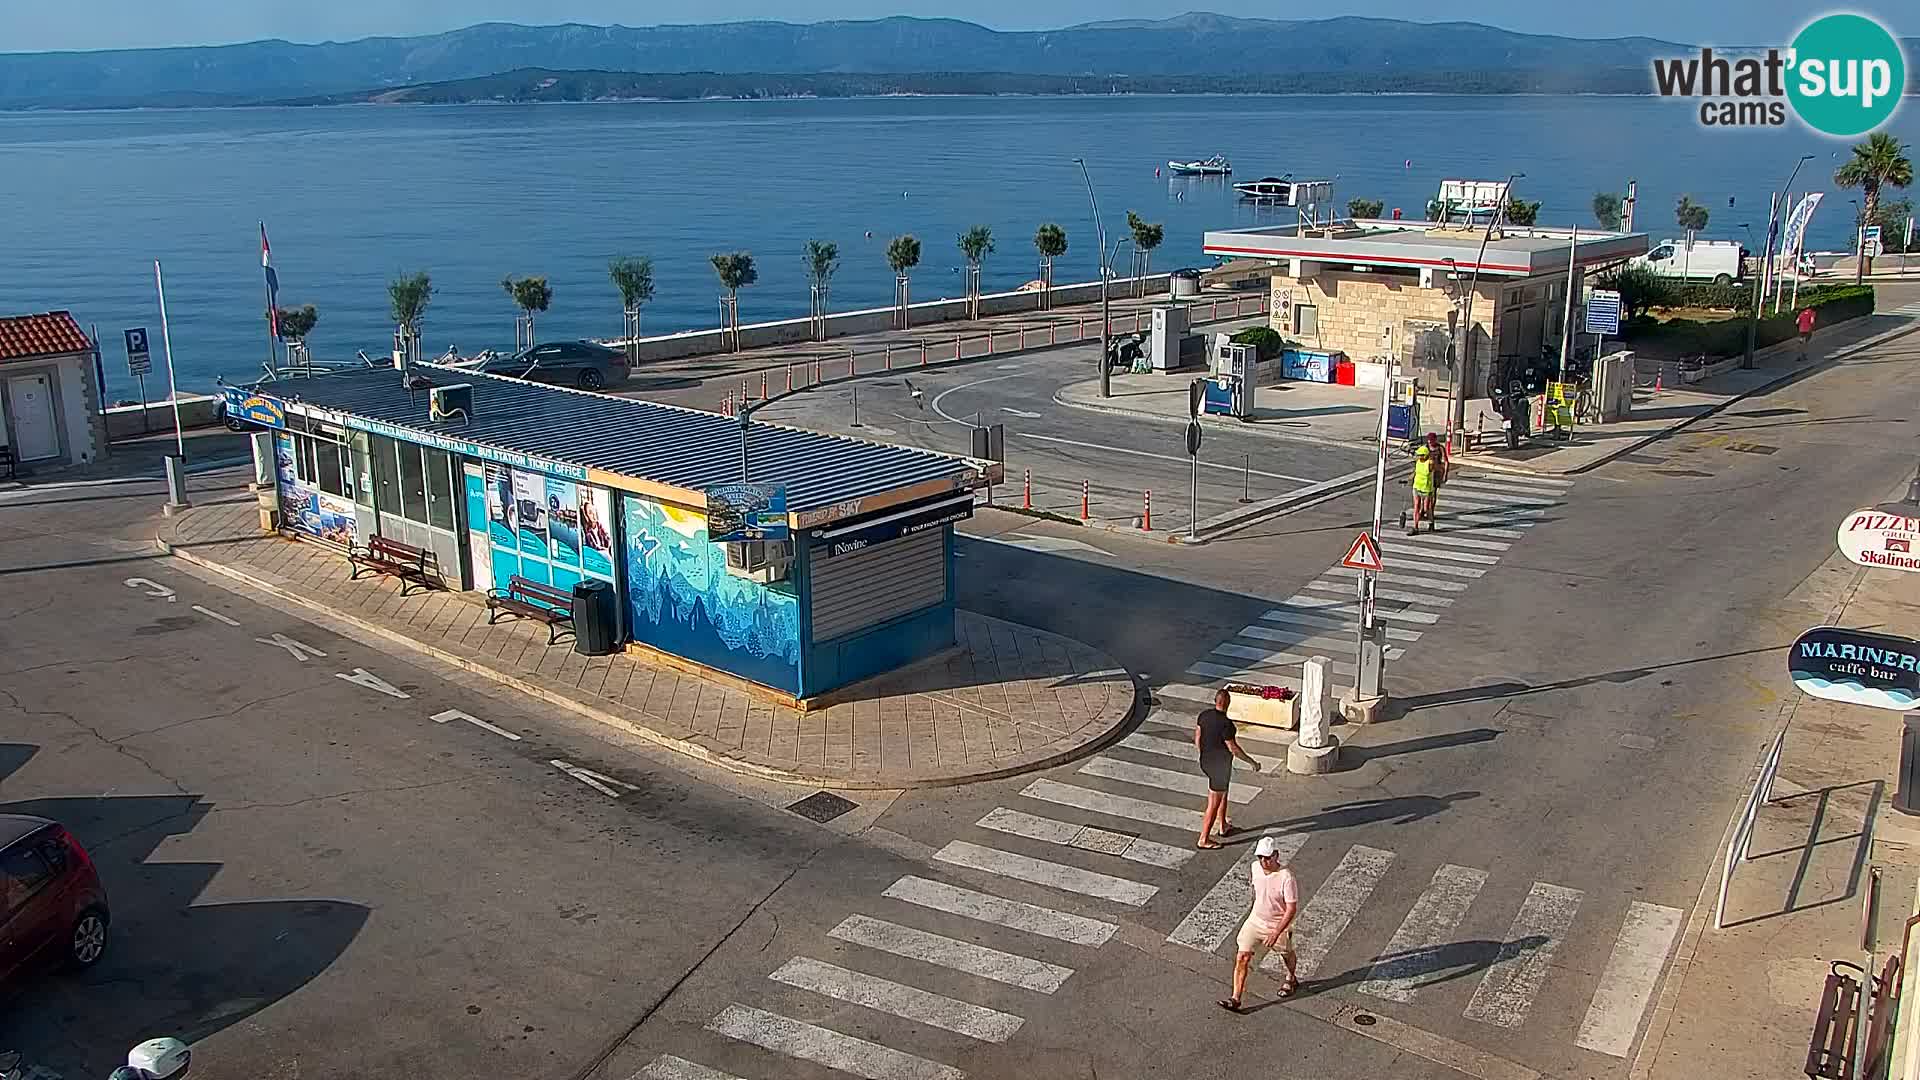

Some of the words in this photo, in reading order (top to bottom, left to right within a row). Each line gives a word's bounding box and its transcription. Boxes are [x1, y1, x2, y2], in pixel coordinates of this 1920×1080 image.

[130, 332, 142, 350] P
[395, 427, 436, 445] AUTOBUSNA
[436, 435, 468, 452] POSTAJA
[477, 447, 492, 459] BUS
[493, 450, 526, 465] STATION
[527, 457, 554, 471] TICKET
[554, 463, 582, 477] OFFICE
[1881, 530, 1918, 541] GRILL
[1829, 661, 1866, 676] caffe
[1870, 665, 1897, 681] bar
